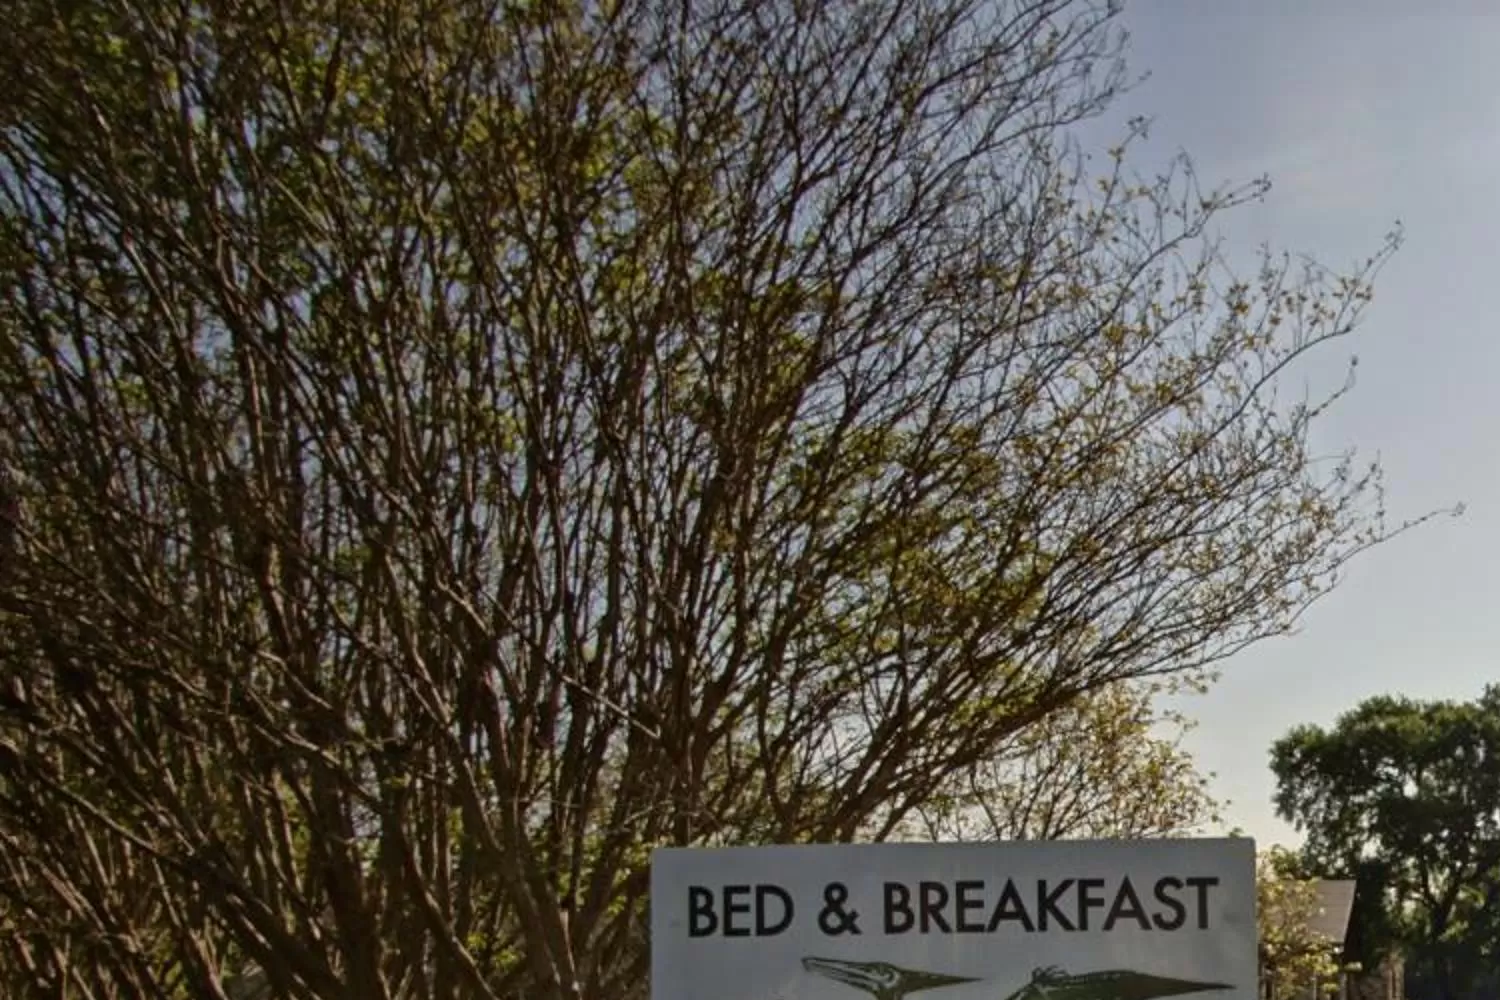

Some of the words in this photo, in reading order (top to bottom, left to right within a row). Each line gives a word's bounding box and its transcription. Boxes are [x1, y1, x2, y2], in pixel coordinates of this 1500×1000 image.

[688, 883, 795, 938] BED
[817, 881, 862, 936] &
[882, 875, 1220, 935] BREAKFAST
